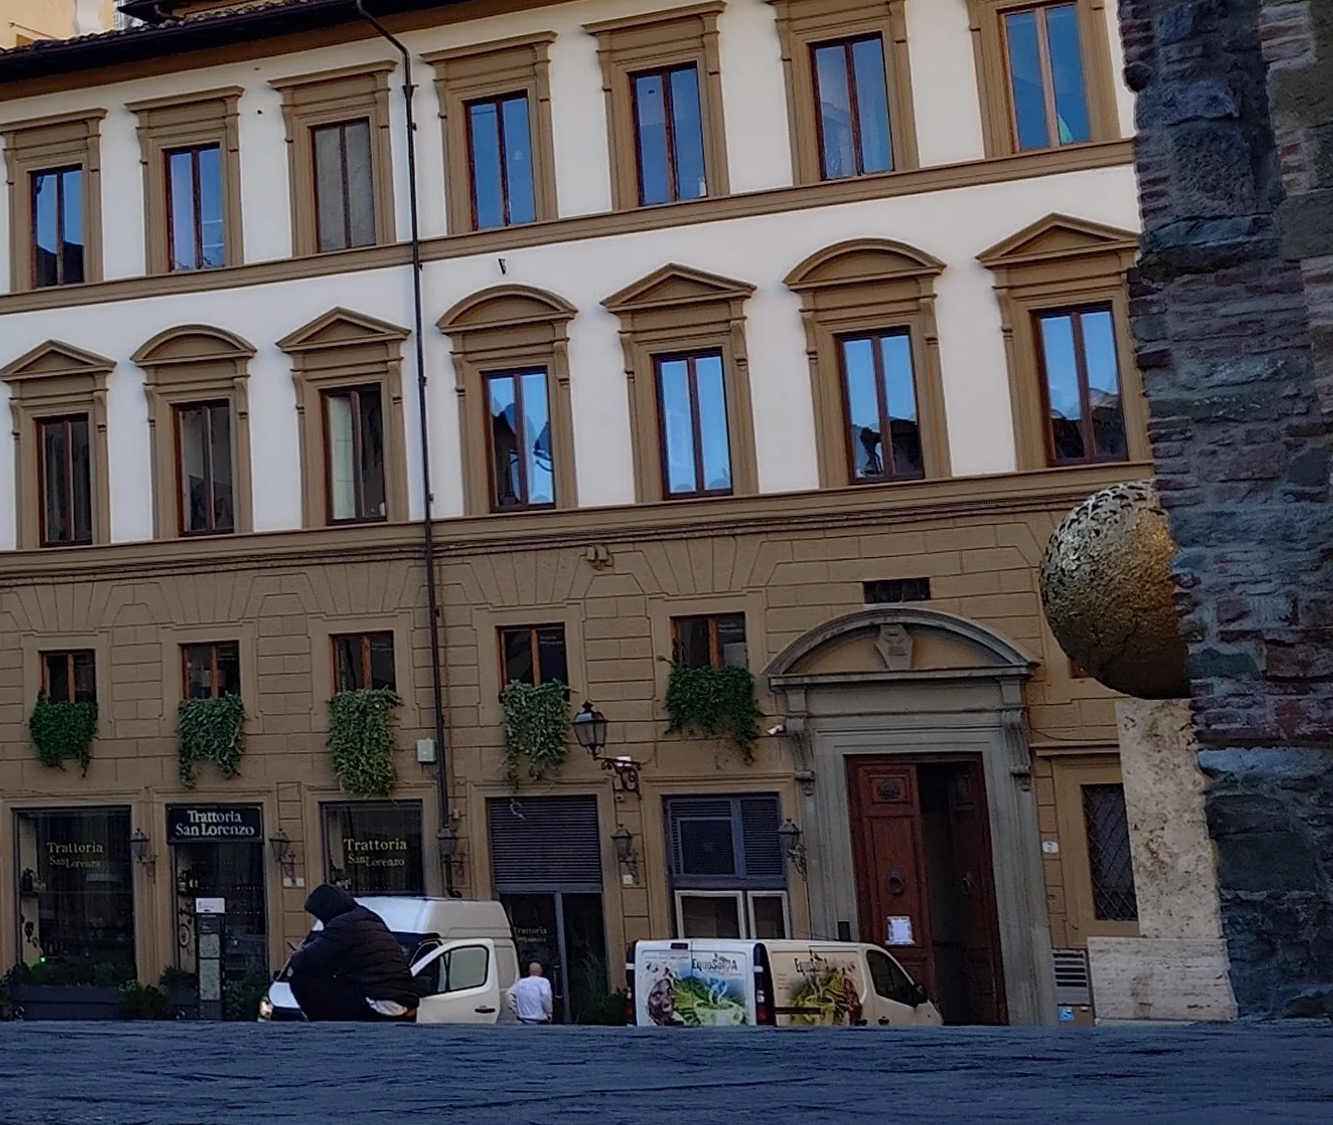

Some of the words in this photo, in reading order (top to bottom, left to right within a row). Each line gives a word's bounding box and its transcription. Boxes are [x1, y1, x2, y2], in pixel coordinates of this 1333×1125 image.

[186, 810, 242, 823] Trattoria
[175, 823, 200, 836] San
[201, 824, 255, 836] Lorenzo
[46, 841, 104, 853] Trattoria
[343, 838, 407, 851] Trattoria
